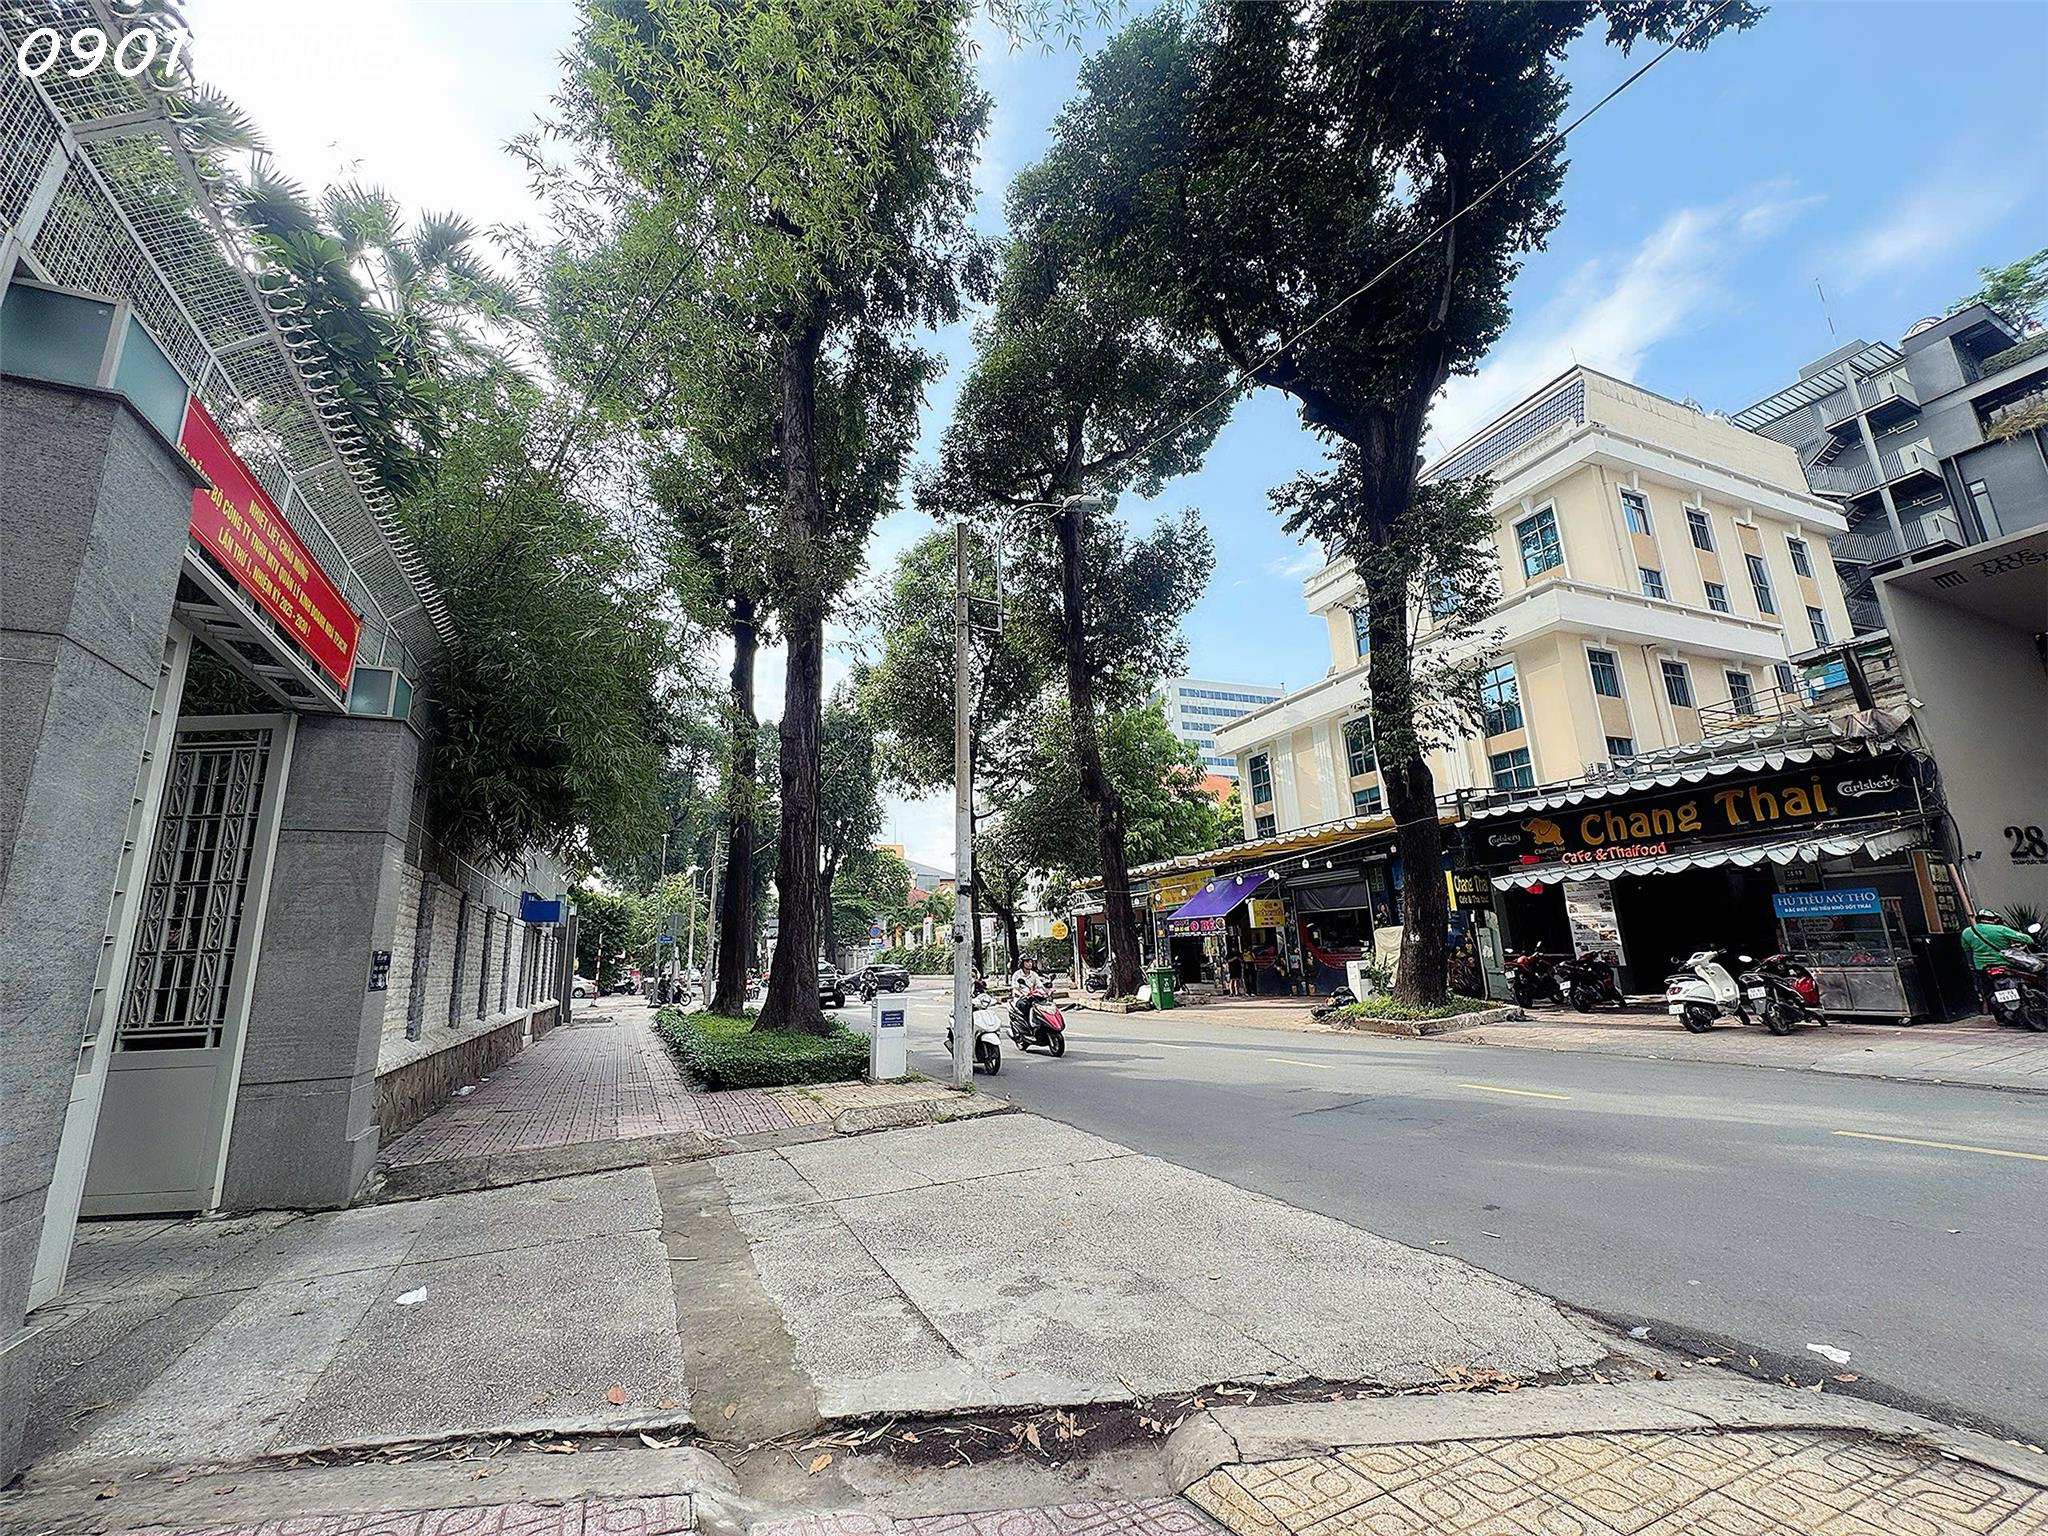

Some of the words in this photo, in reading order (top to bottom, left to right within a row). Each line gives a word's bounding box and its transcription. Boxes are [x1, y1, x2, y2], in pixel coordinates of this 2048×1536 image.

[222, 499, 243, 531] CÔNG
[242, 521, 252, 541] TY
[1580, 800, 1702, 846] Chang
[1713, 775, 1829, 826] Thai
[2003, 825, 2047, 859] 28
[1845, 891, 1876, 902] THO
